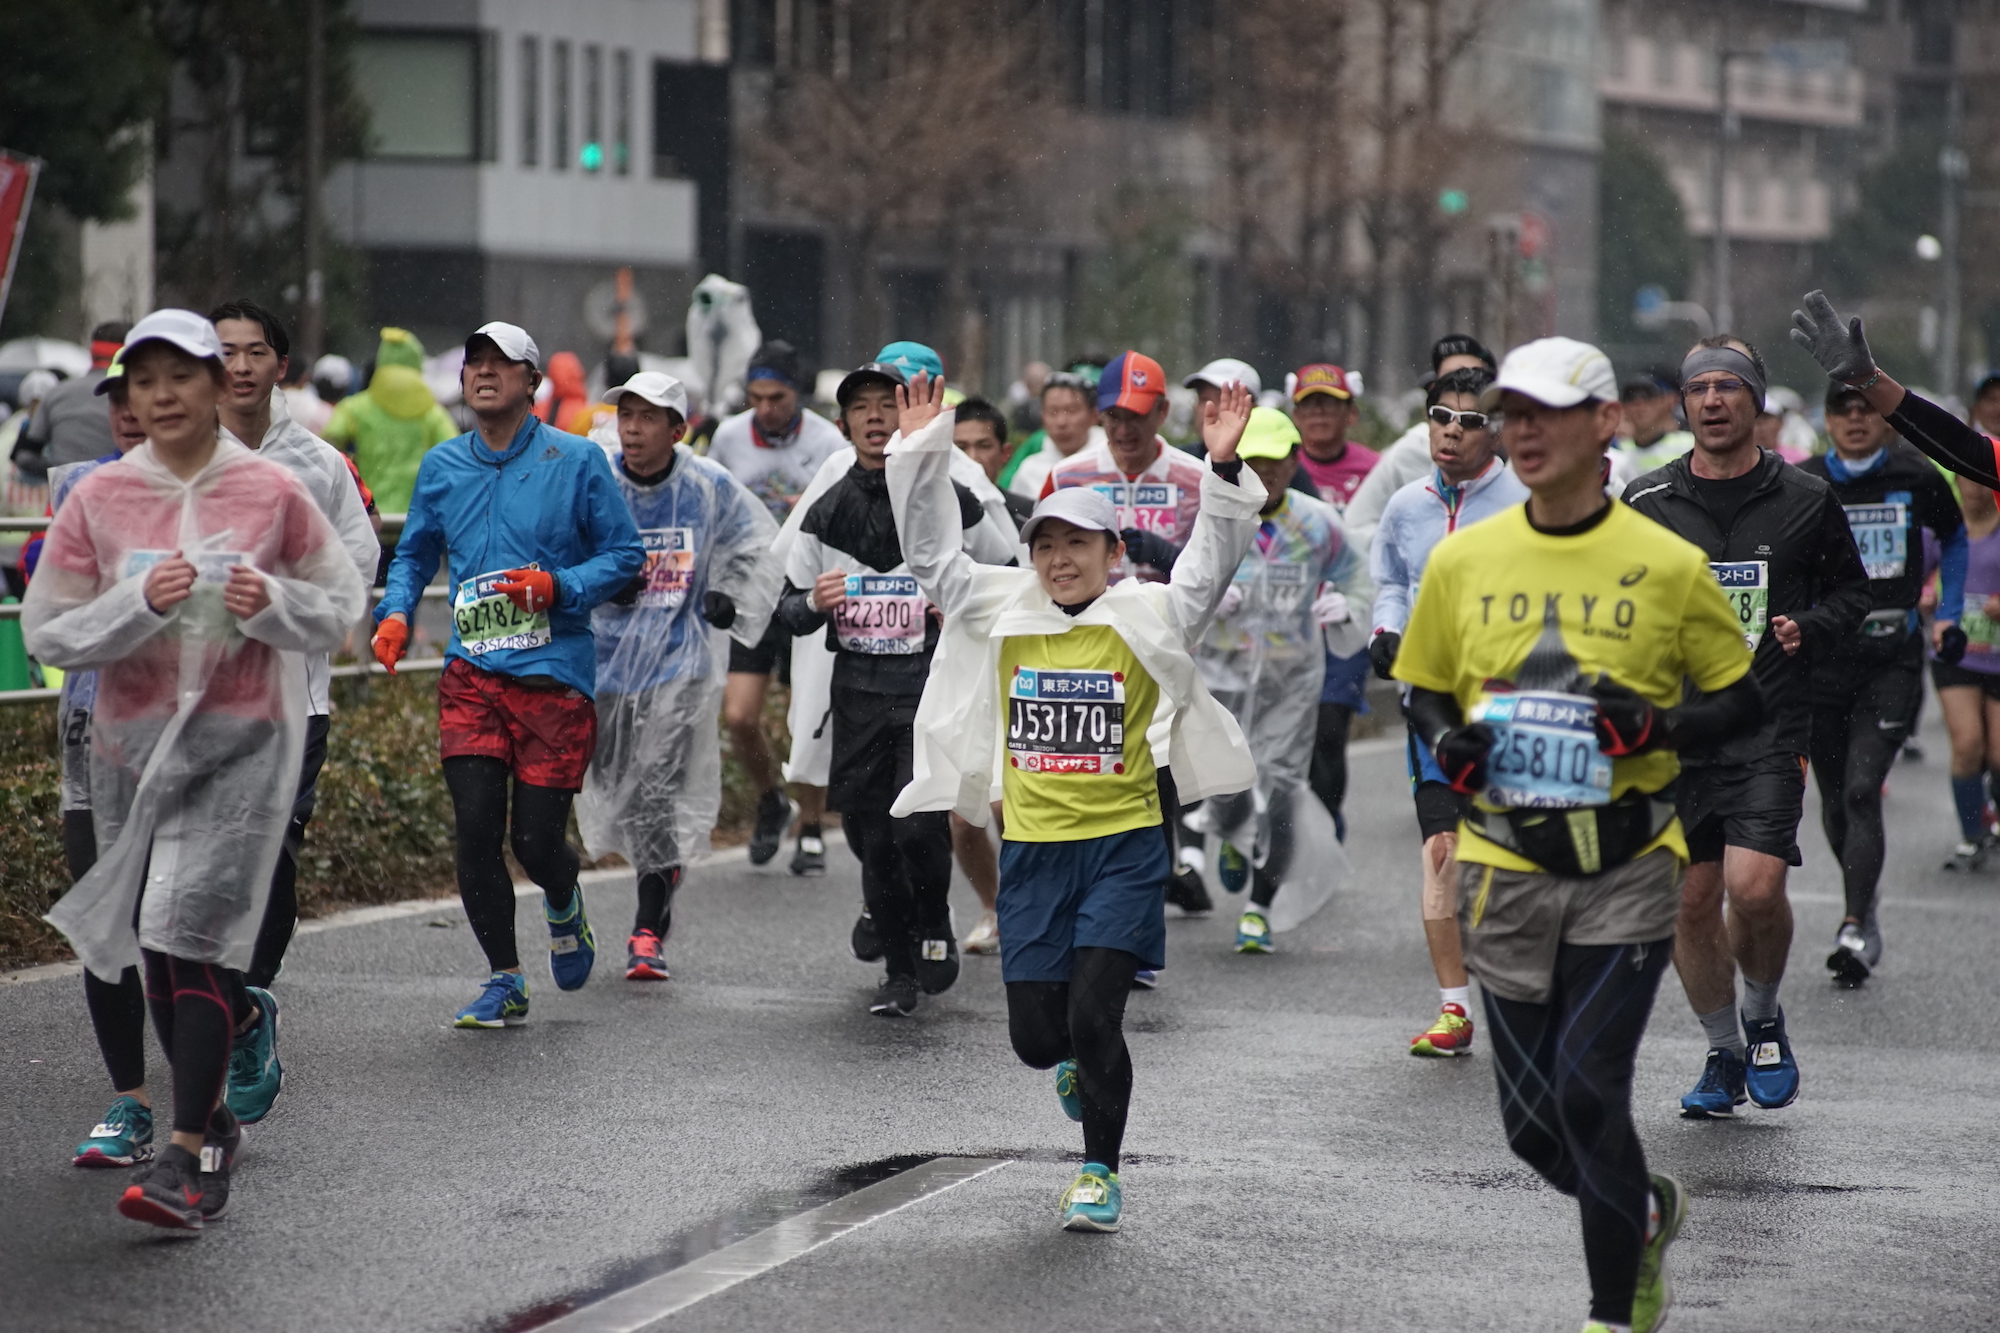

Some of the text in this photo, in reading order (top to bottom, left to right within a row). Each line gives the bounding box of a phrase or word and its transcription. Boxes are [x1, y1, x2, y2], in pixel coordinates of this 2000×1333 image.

[1853, 528, 1894, 556] 619
[864, 580, 916, 592] 東京メトロ
[1481, 592, 1636, 629] TOKYO
[1041, 678, 1110, 693] 東京メトロ
[1010, 701, 1107, 743] J53170
[1518, 701, 1598, 727] 東京メトロ
[1042, 757, 1099, 771] ヤマザキ
